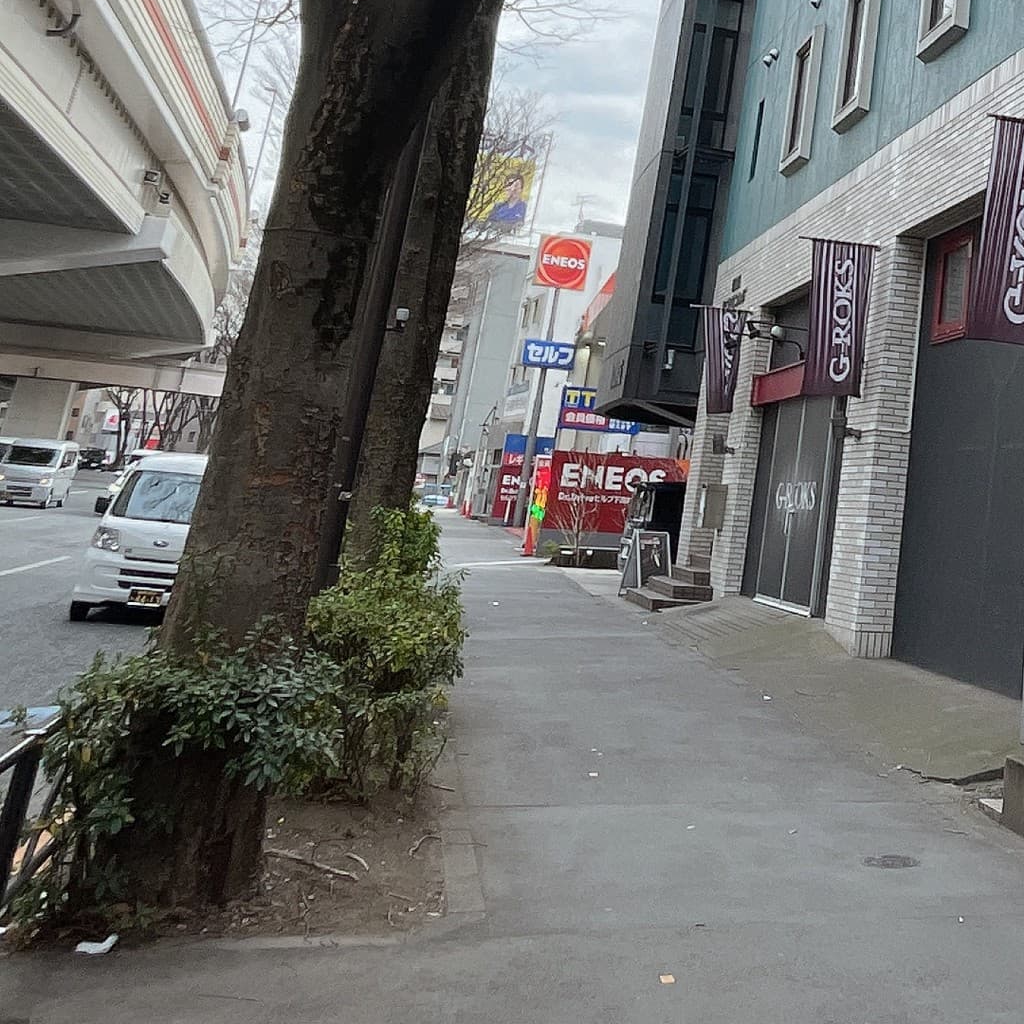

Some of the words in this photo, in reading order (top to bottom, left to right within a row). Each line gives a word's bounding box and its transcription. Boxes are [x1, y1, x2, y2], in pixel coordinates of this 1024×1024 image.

[542, 254, 585, 270] ENEOS
[829, 259, 854, 382] G-ROKS
[527, 342, 574, 366] セルフ
